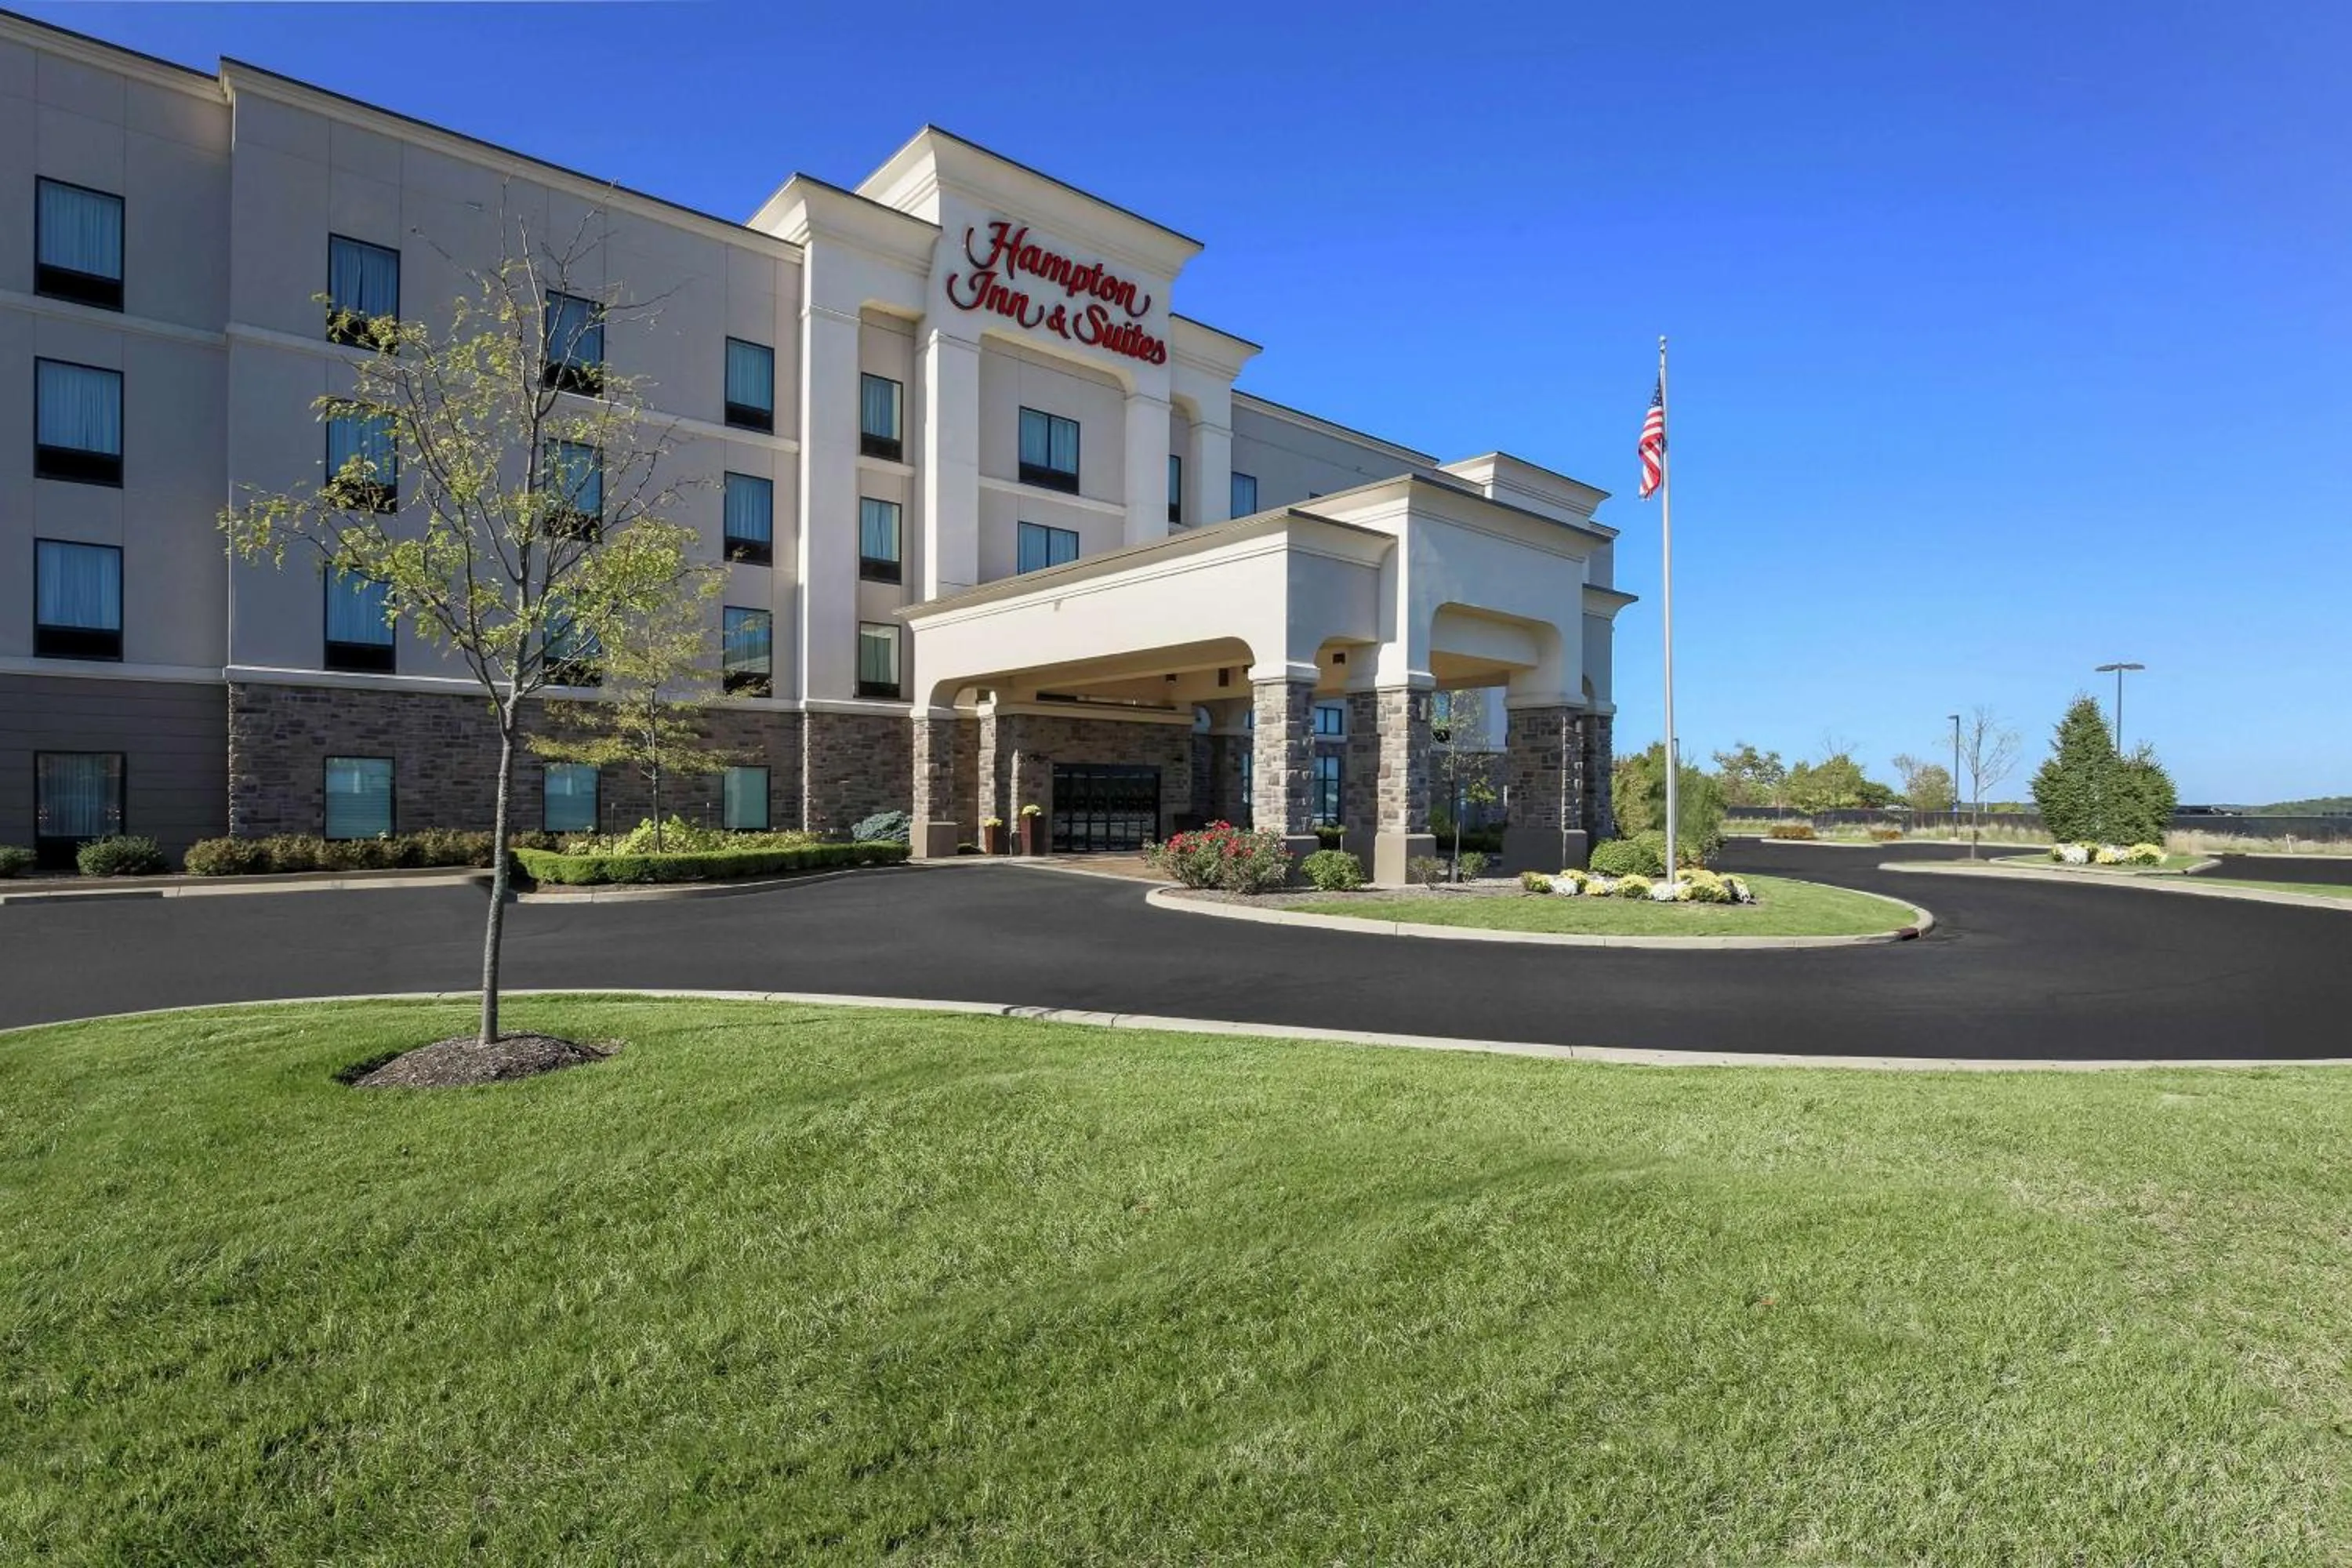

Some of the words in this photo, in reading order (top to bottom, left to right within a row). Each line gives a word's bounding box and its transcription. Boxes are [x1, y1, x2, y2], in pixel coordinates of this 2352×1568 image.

[965, 222, 1151, 318] Hampton
[947, 271, 1044, 328] Inn
[1047, 304, 1071, 339] &
[1073, 303, 1167, 365] Suites
